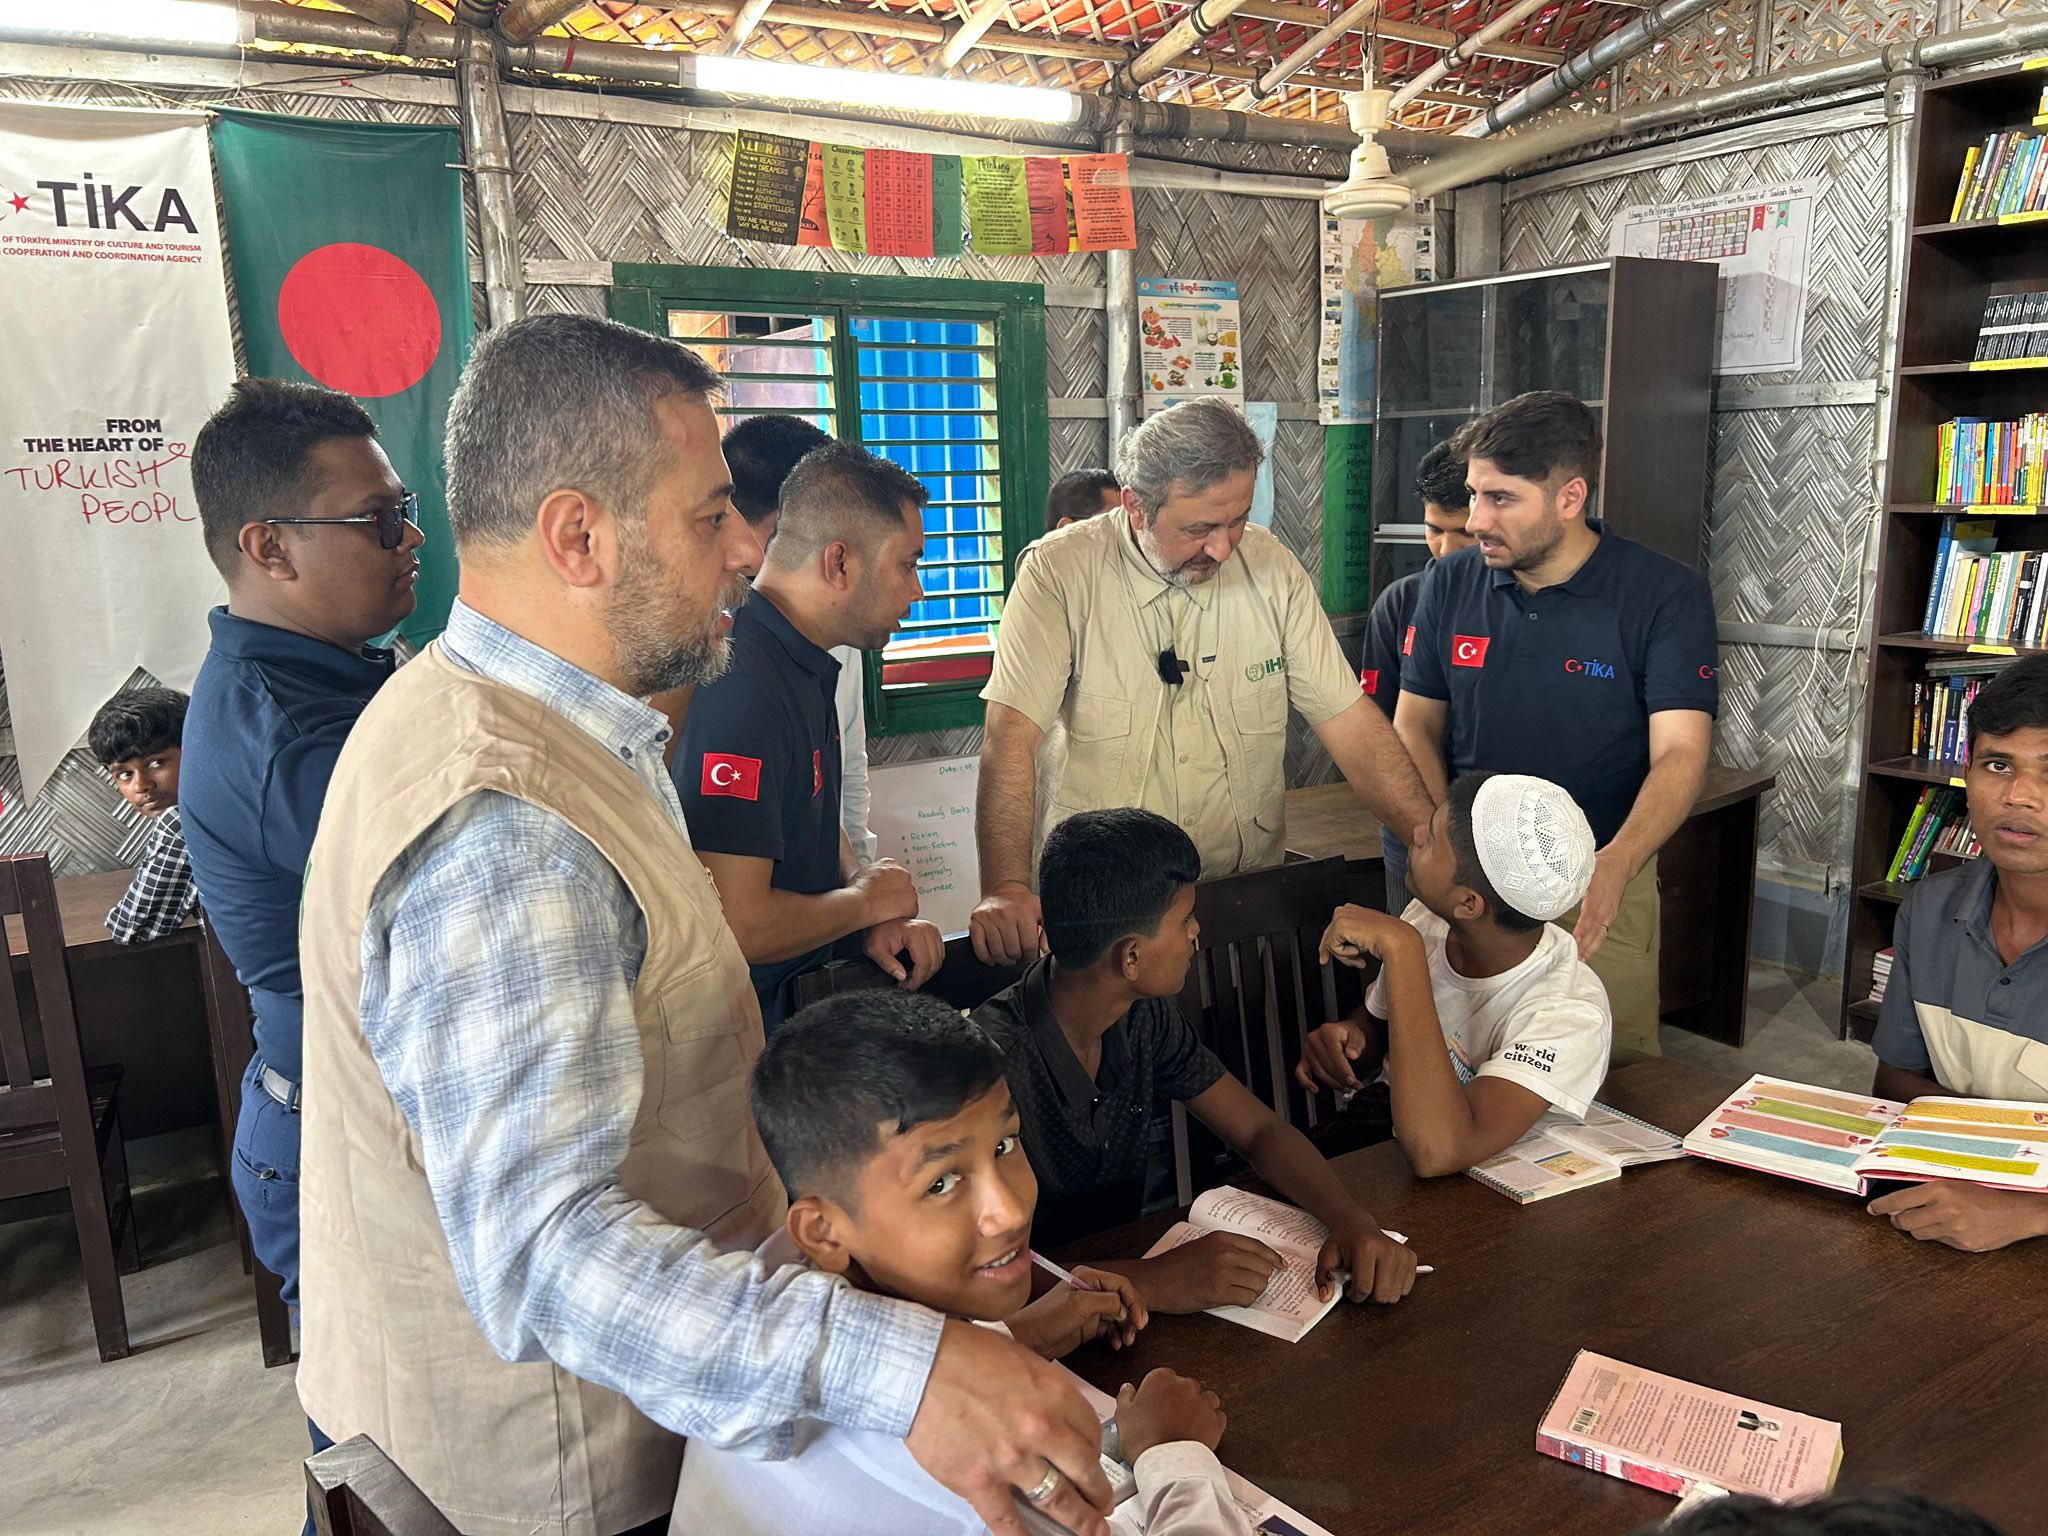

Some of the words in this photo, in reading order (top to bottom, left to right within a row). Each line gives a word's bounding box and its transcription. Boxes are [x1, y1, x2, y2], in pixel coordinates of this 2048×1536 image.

[747, 141, 799, 160] LIBRARY
[37, 172, 199, 234] TİKA
[2, 235, 13, 243] OF
[15, 236, 51, 245] TÜRKİYE
[52, 238, 93, 247] MINISTRY
[107, 241, 144, 249] CULTURE
[164, 243, 201, 252] TOURISM
[3, 247, 70, 257] COOPERATION
[94, 251, 164, 262] COORDINATION
[166, 255, 202, 263] AGENCY
[106, 419, 161, 433] FROM
[23, 438, 64, 452] THE
[68, 438, 133, 452] HEART
[138, 438, 164, 451] OF
[4, 459, 161, 490] TURKISH
[82, 492, 197, 523] PEOPL
[1930, 552, 1944, 597] ENCYCLOPEDIA
[1989, 559, 2000, 594] MUHAMMAD
[1583, 659, 1615, 680] TİKA
[1504, 1051, 1551, 1073] citizen
[1514, 1043, 1556, 1063] world
